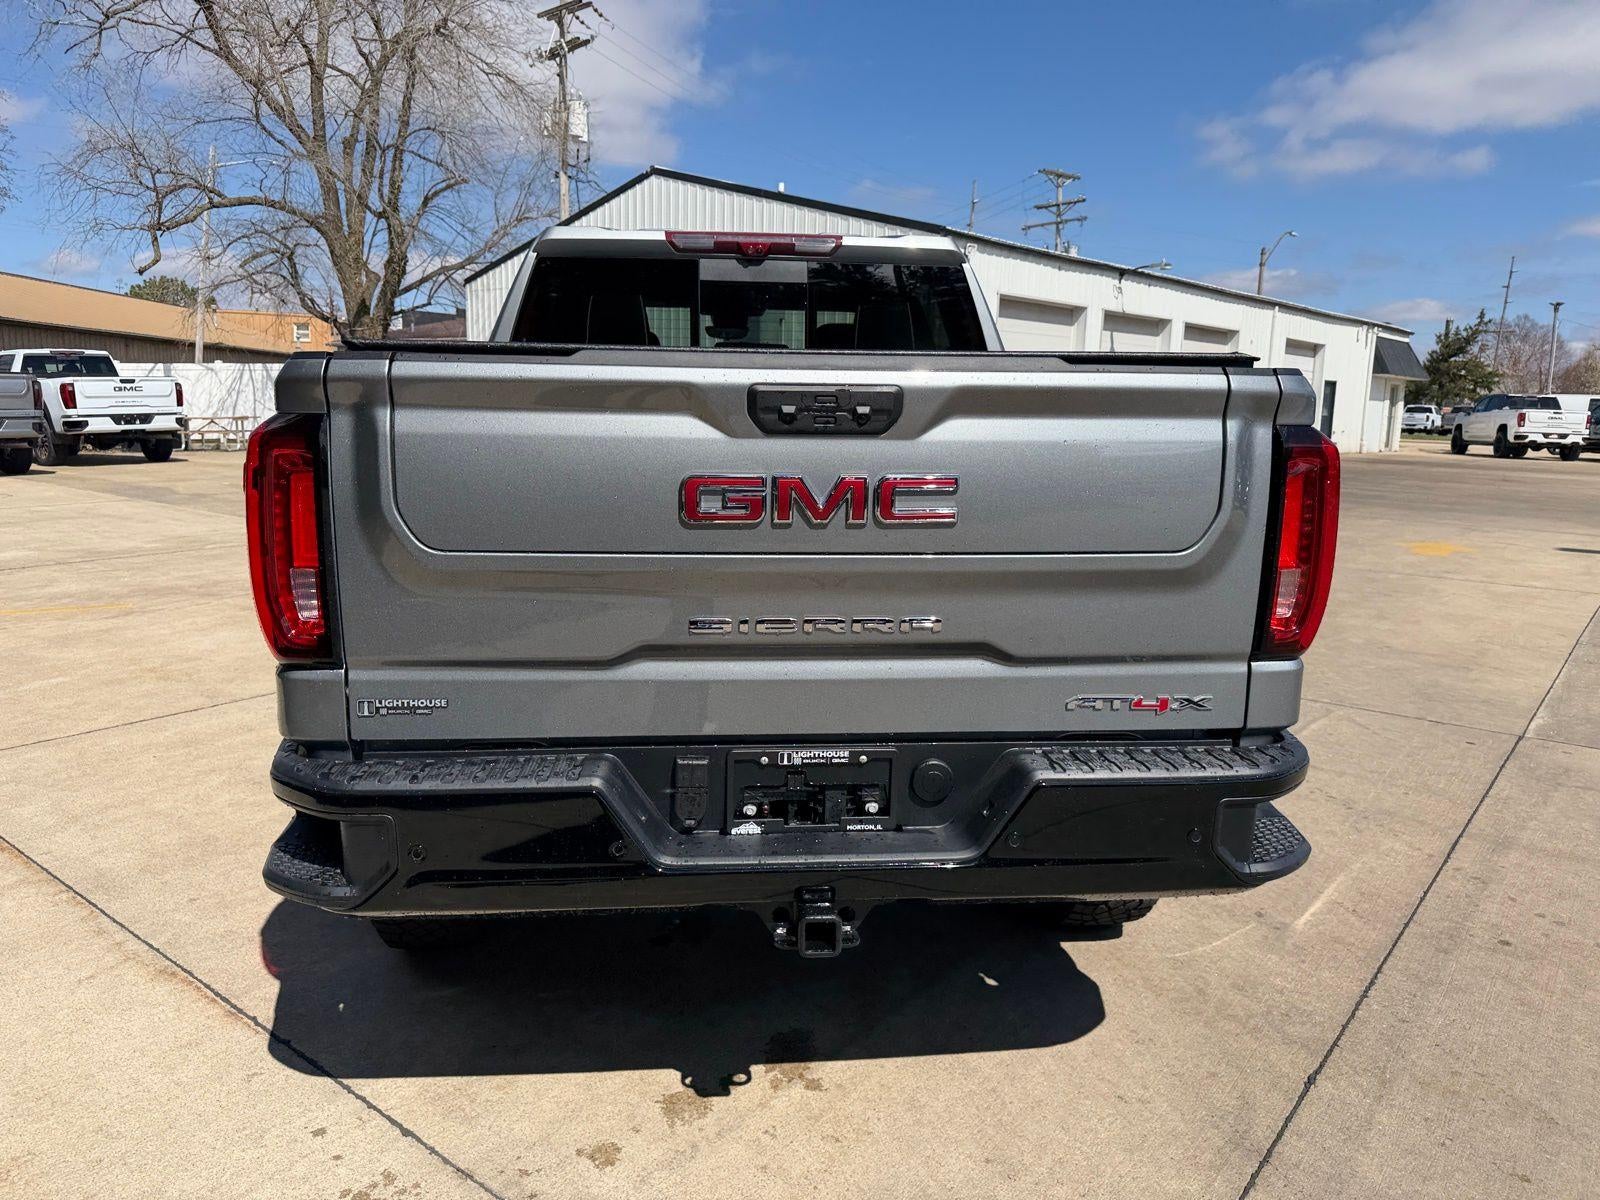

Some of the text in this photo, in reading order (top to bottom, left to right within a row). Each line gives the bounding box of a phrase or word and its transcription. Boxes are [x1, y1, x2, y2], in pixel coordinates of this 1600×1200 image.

[679, 473, 959, 528] GMC
[689, 616, 943, 635] SIERRA
[376, 699, 448, 708] LIGHTHOUSE
[1065, 694, 1214, 715] AT4X
[793, 750, 850, 758] LIGHTHOUSE
